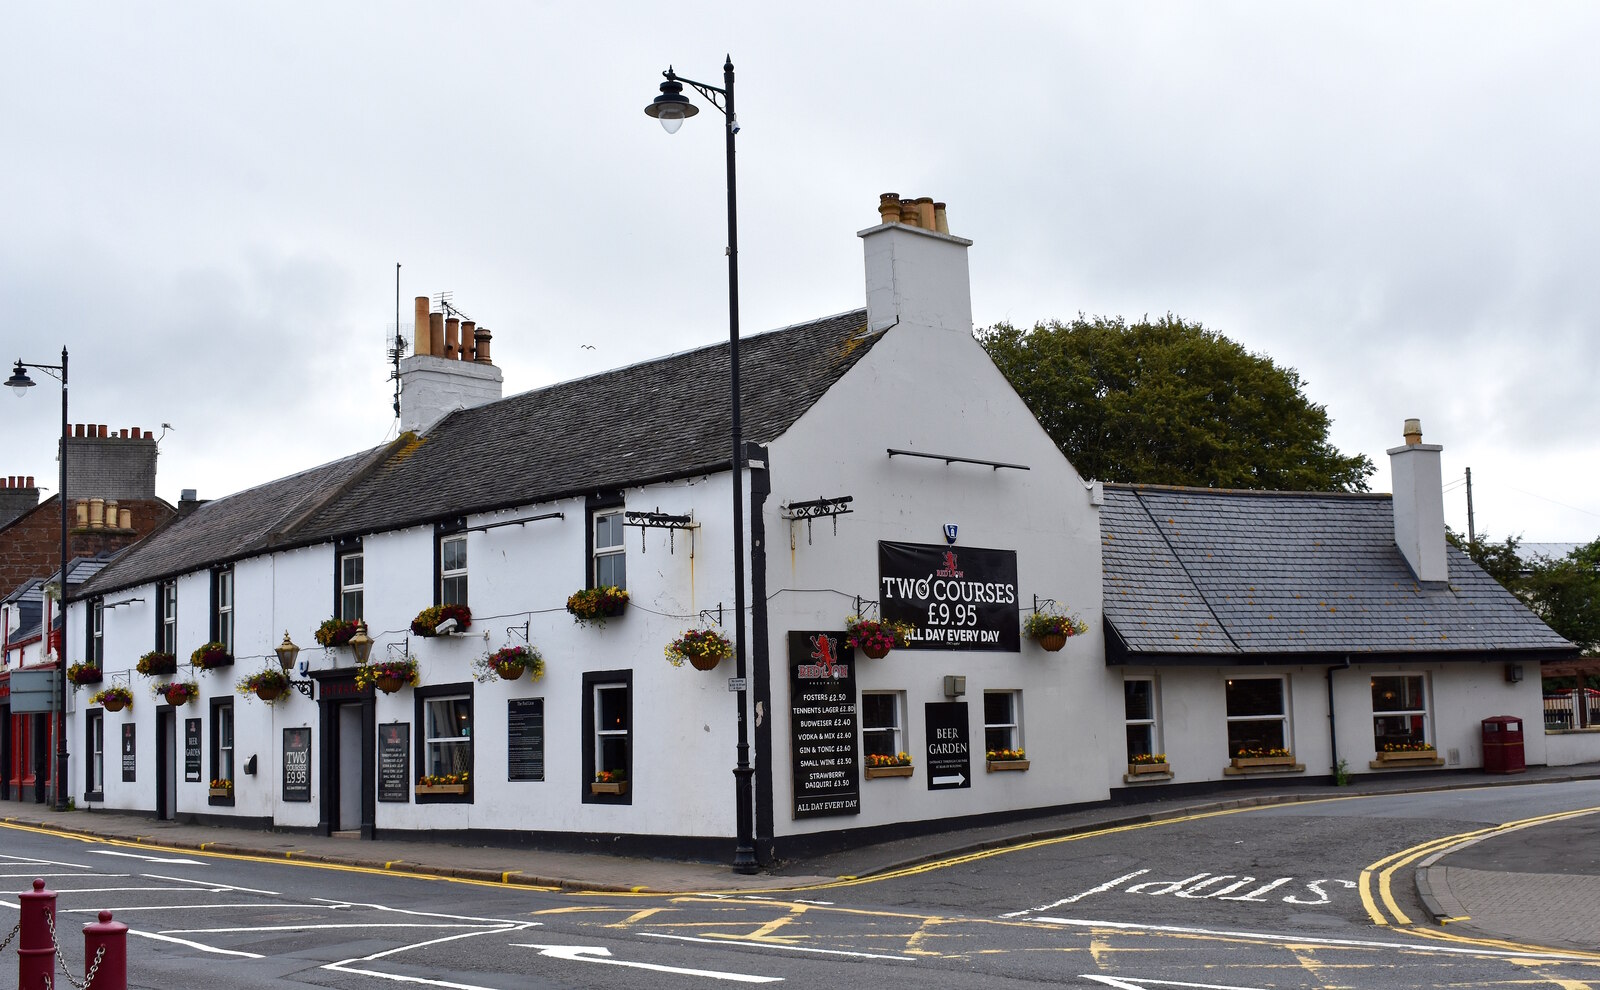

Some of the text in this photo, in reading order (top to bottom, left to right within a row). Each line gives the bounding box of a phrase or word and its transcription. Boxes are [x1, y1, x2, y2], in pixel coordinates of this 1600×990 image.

[882, 574, 1015, 604] TWO COURSES
[928, 603, 977, 626] £9.95
[904, 628, 1000, 643] ALL DAY EVERY DAY
[798, 665, 821, 678] RED
[829, 693, 847, 702] £2.50
[834, 718, 851, 726] £2.40
[936, 728, 959, 741] BEER
[188, 737, 198, 745] BEER
[185, 748, 201, 757] GARDEN
[928, 743, 968, 754] GARDEN
[286, 748, 308, 764] TWO
[837, 757, 852, 765] £2.50
[286, 763, 306, 771] COURSES
[286, 771, 306, 784] £9.95
[809, 771, 846, 780] STRAWBERRY
[805, 781, 832, 789] DAIQUIRI
[798, 800, 857, 812] ALL DAY EVERY DAY
